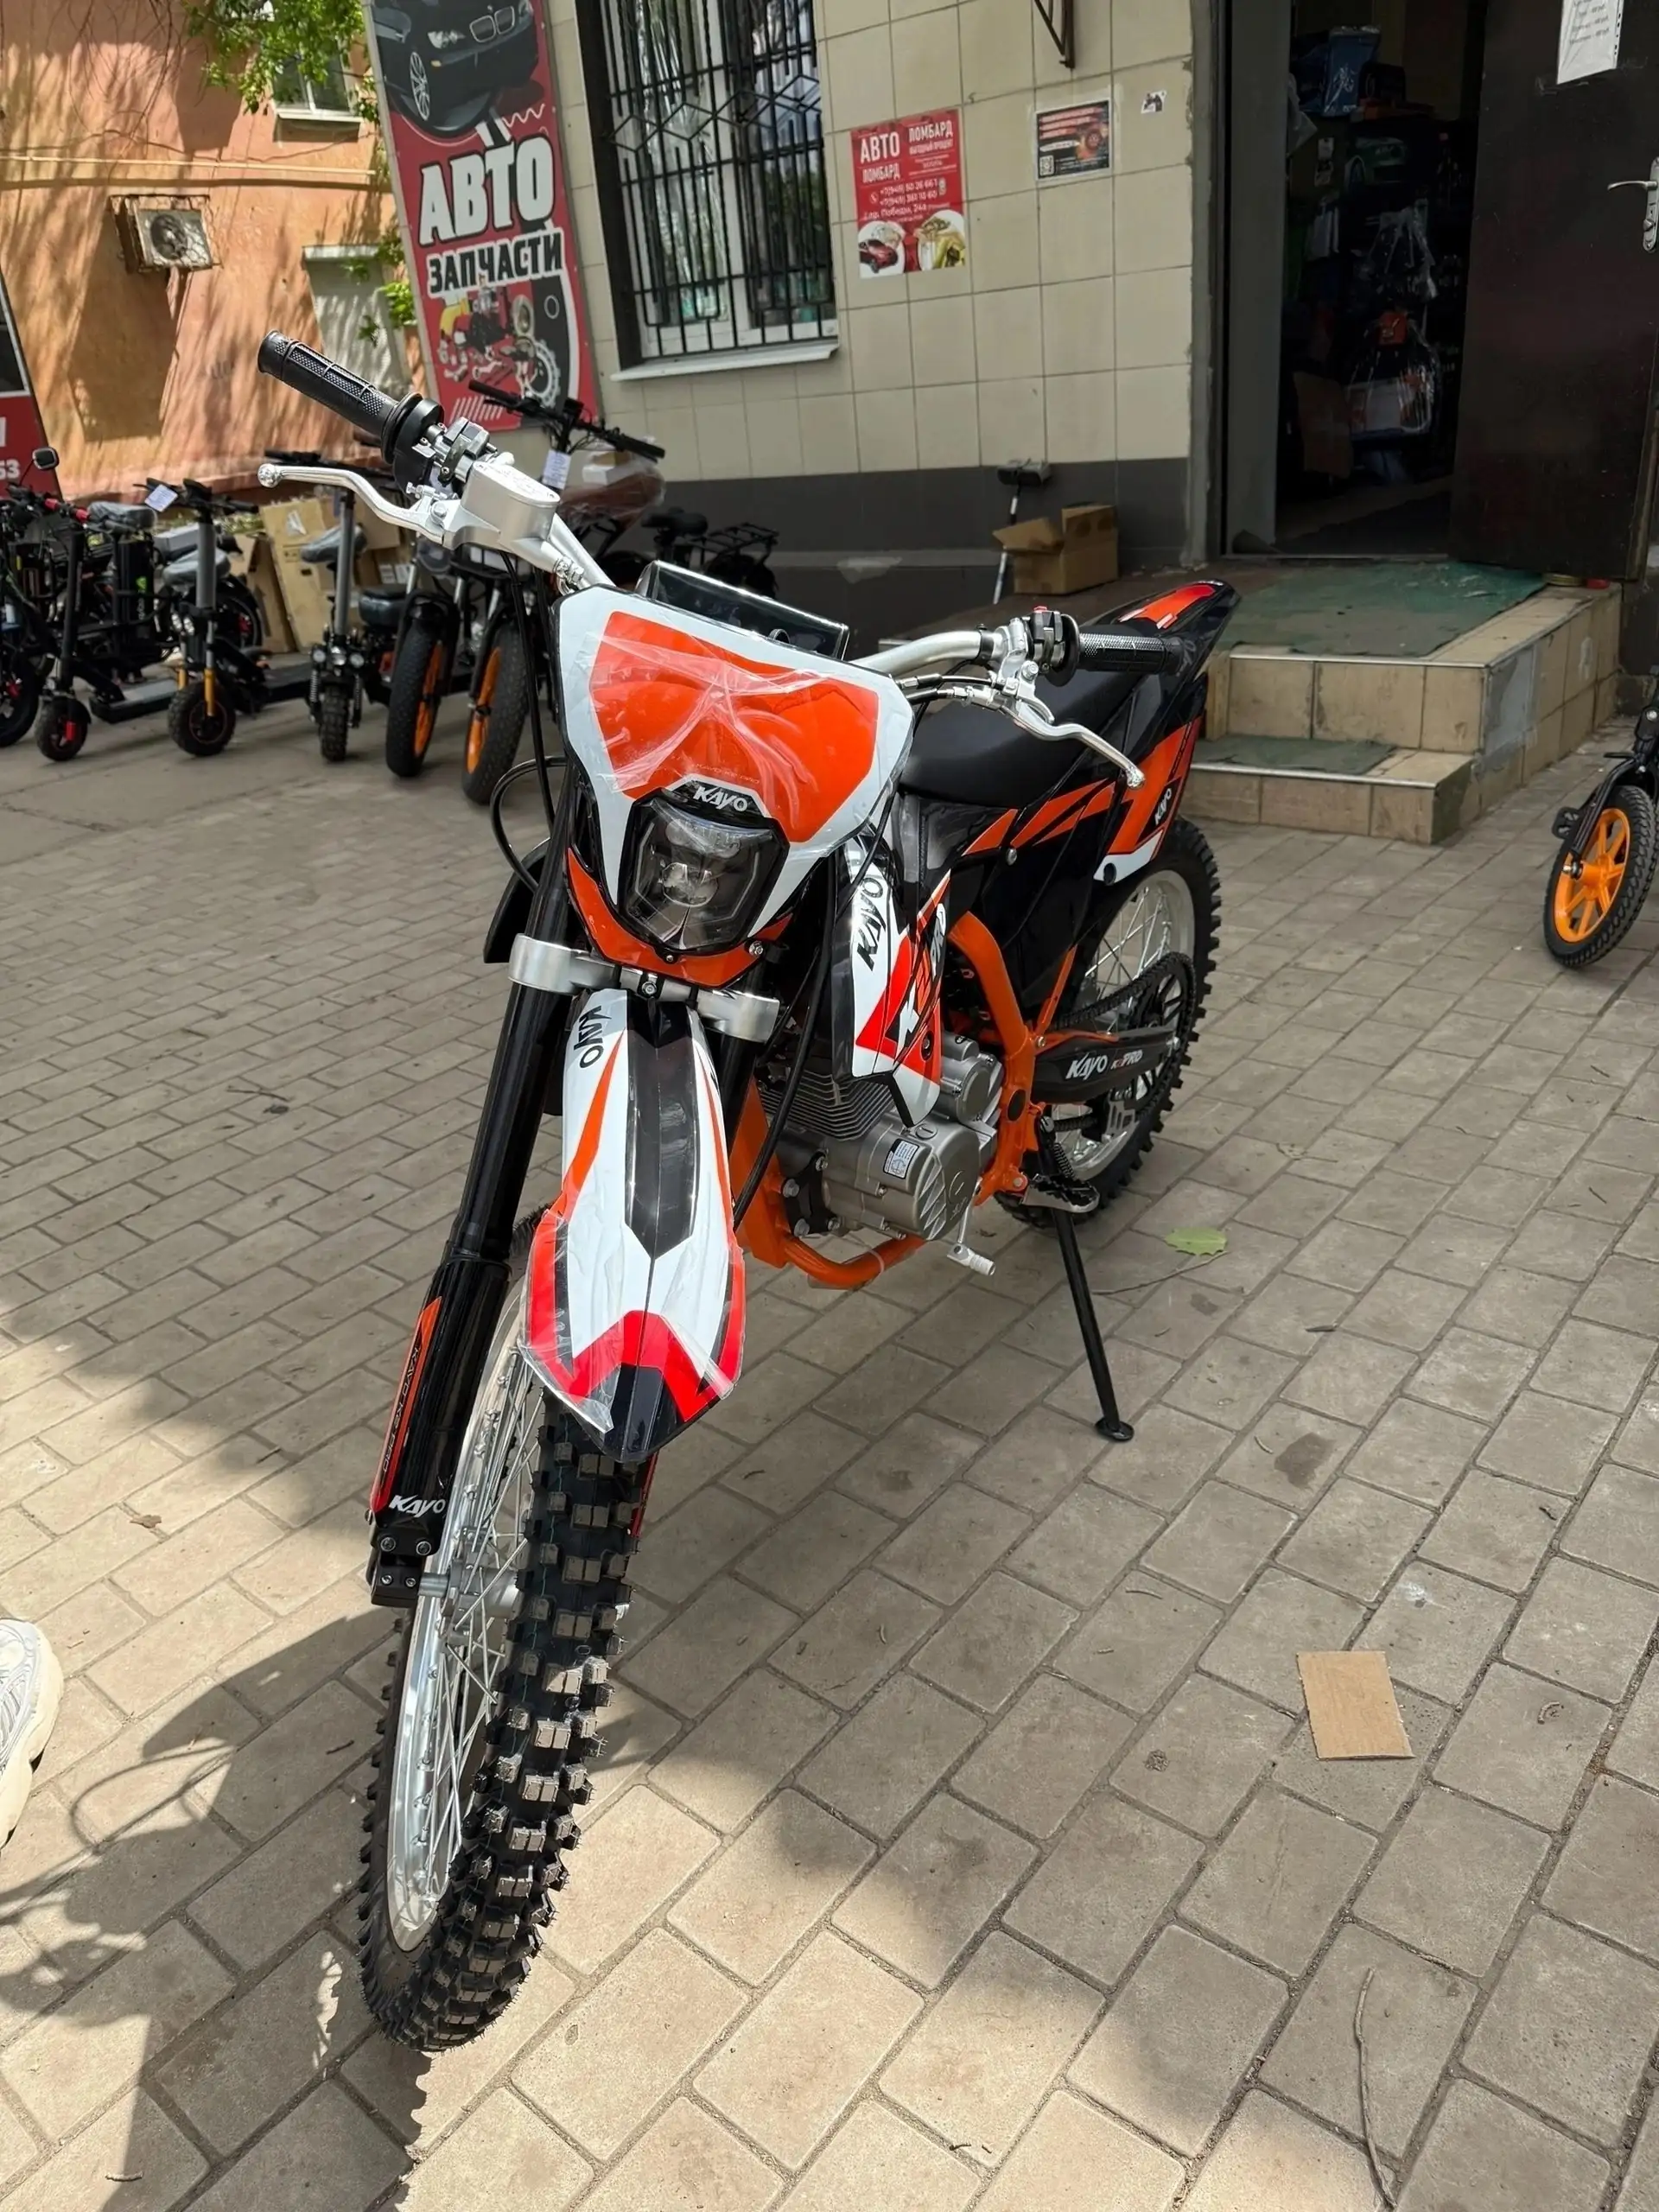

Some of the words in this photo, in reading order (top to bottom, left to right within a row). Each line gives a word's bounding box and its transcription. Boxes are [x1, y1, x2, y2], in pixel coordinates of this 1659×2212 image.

[861, 131, 900, 164] АВТО
[909, 120, 954, 143] ЛОМБАРД
[419, 137, 554, 245] АВТО
[862, 162, 900, 184] ЛОМБАРД
[429, 232, 563, 294] ЗАПЧАСТИ
[693, 785, 748, 812] KAYO
[1154, 788, 1172, 826] KAYO
[857, 877, 887, 972] KAYO
[574, 1005, 612, 1069] KAYO
[1065, 1052, 1108, 1080] KAYO
[402, 1346, 420, 1397] KAYO
[383, 1434, 396, 1473] PRO
[389, 1494, 446, 1518] KAYO
